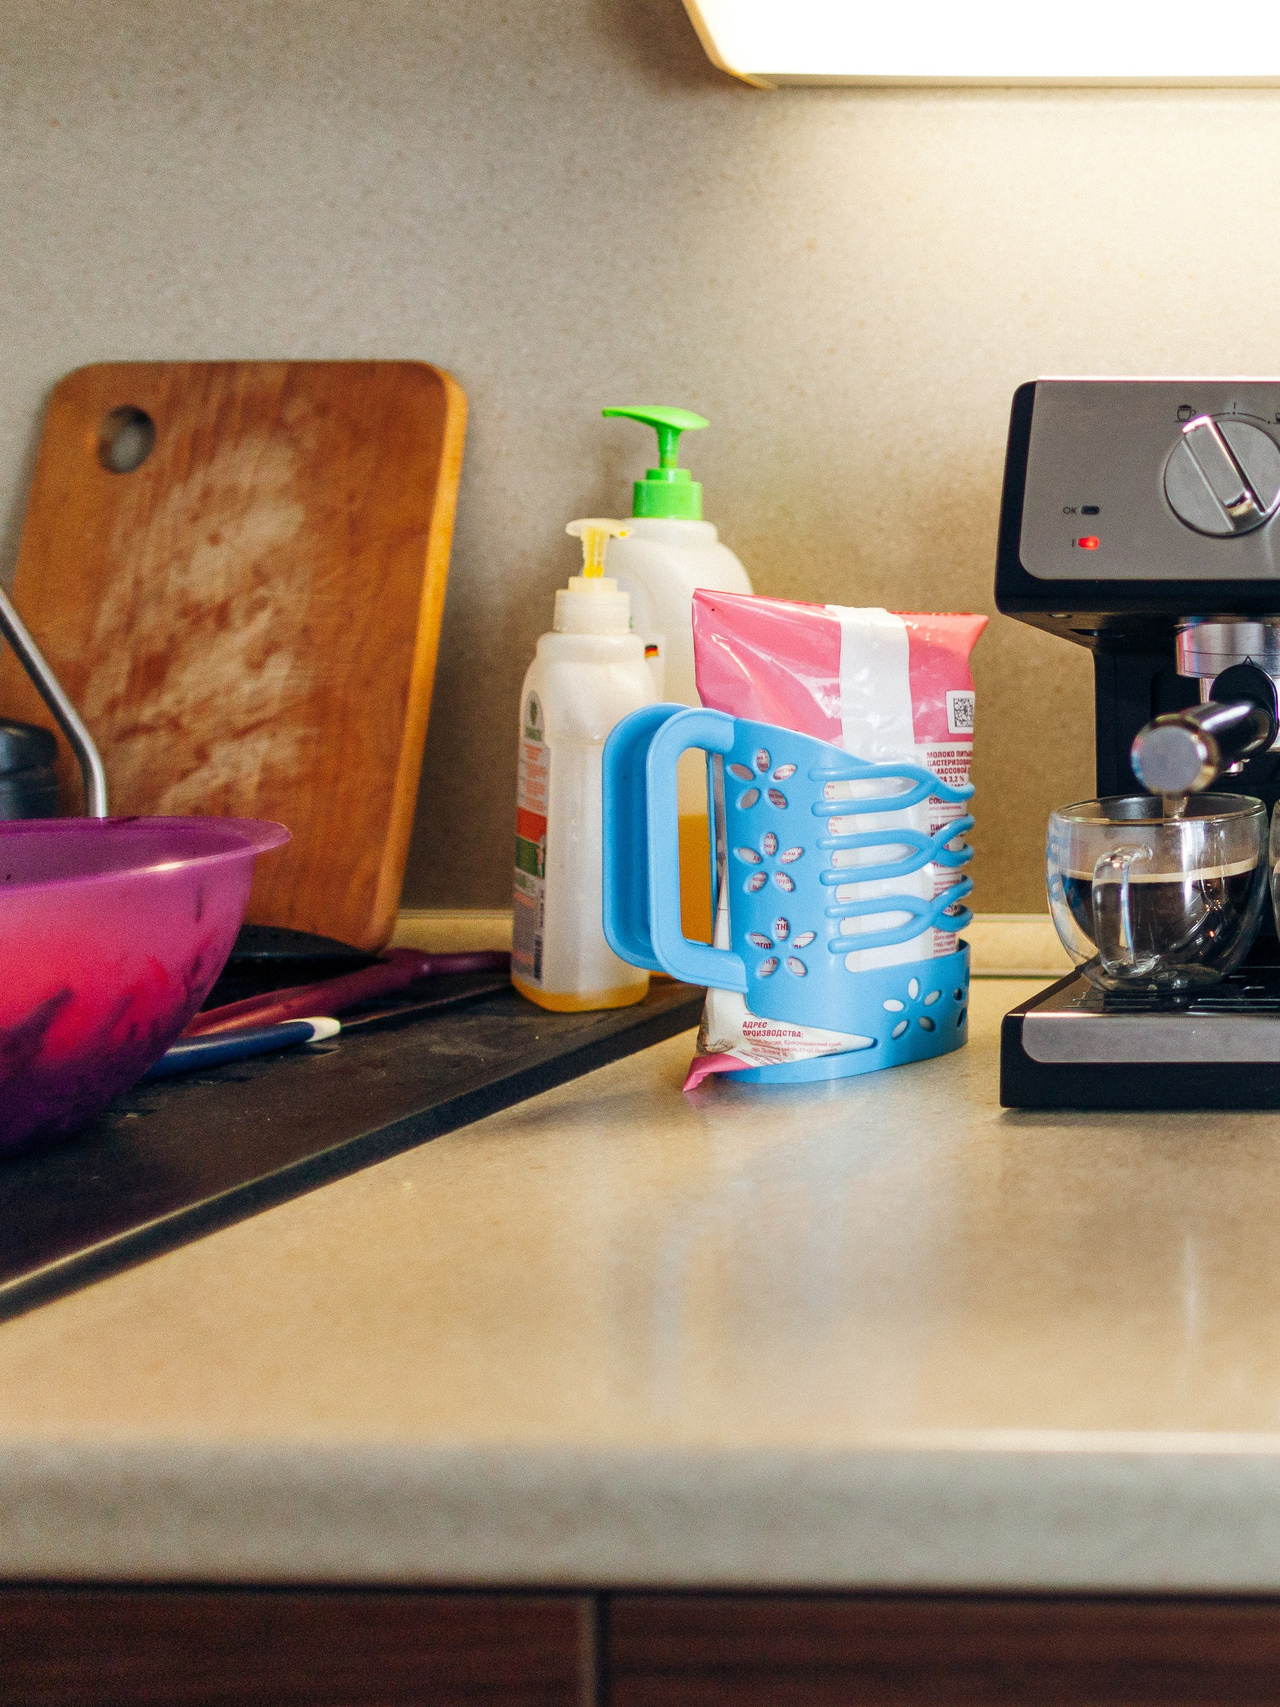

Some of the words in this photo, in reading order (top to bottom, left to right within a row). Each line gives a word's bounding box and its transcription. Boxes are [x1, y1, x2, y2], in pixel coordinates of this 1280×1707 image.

[1063, 506, 1077, 514] OK
[926, 751, 955, 759] МОЛОКО
[742, 1030, 804, 1038] ПРОИЗВОДСТВА:
